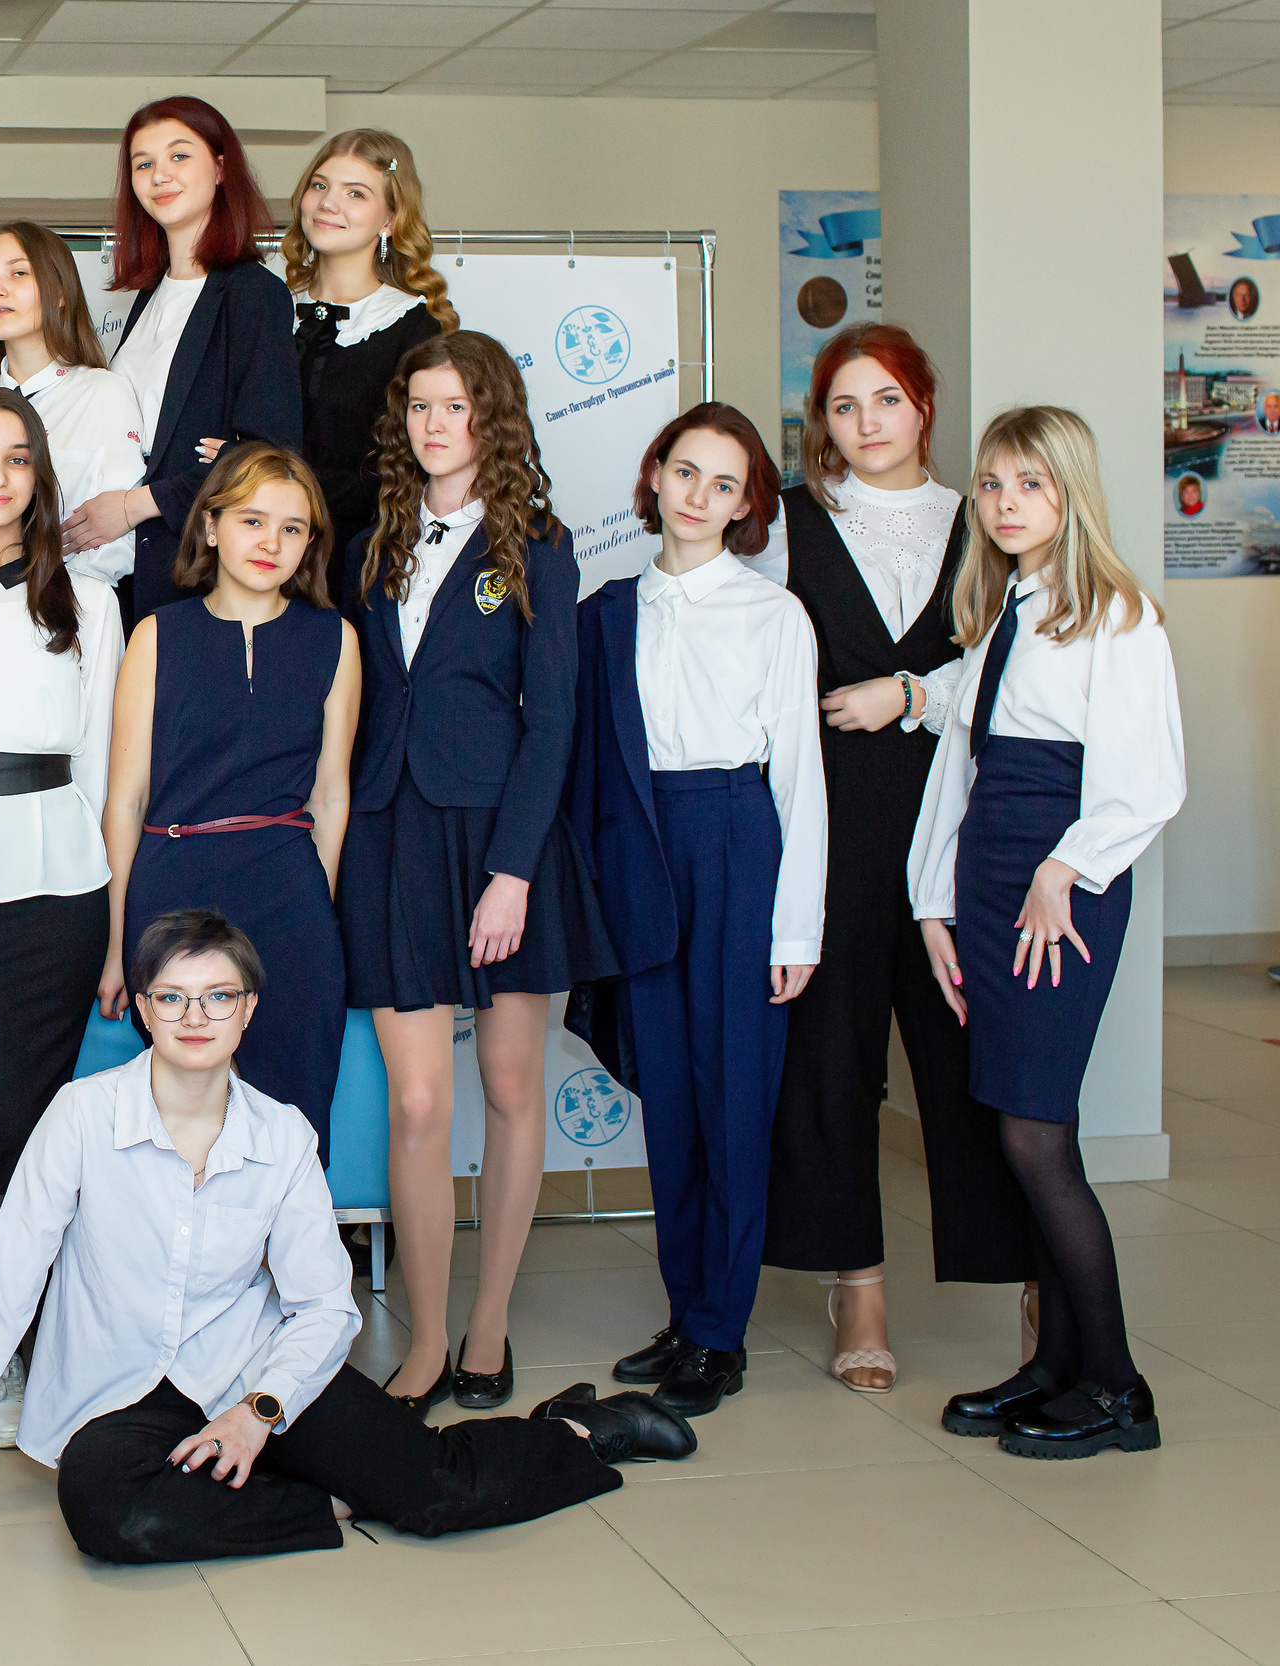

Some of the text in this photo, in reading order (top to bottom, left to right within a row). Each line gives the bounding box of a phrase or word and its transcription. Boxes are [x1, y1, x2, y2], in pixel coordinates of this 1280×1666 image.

[545, 367, 675, 422] Санкт-Петербург Пушкинский район
